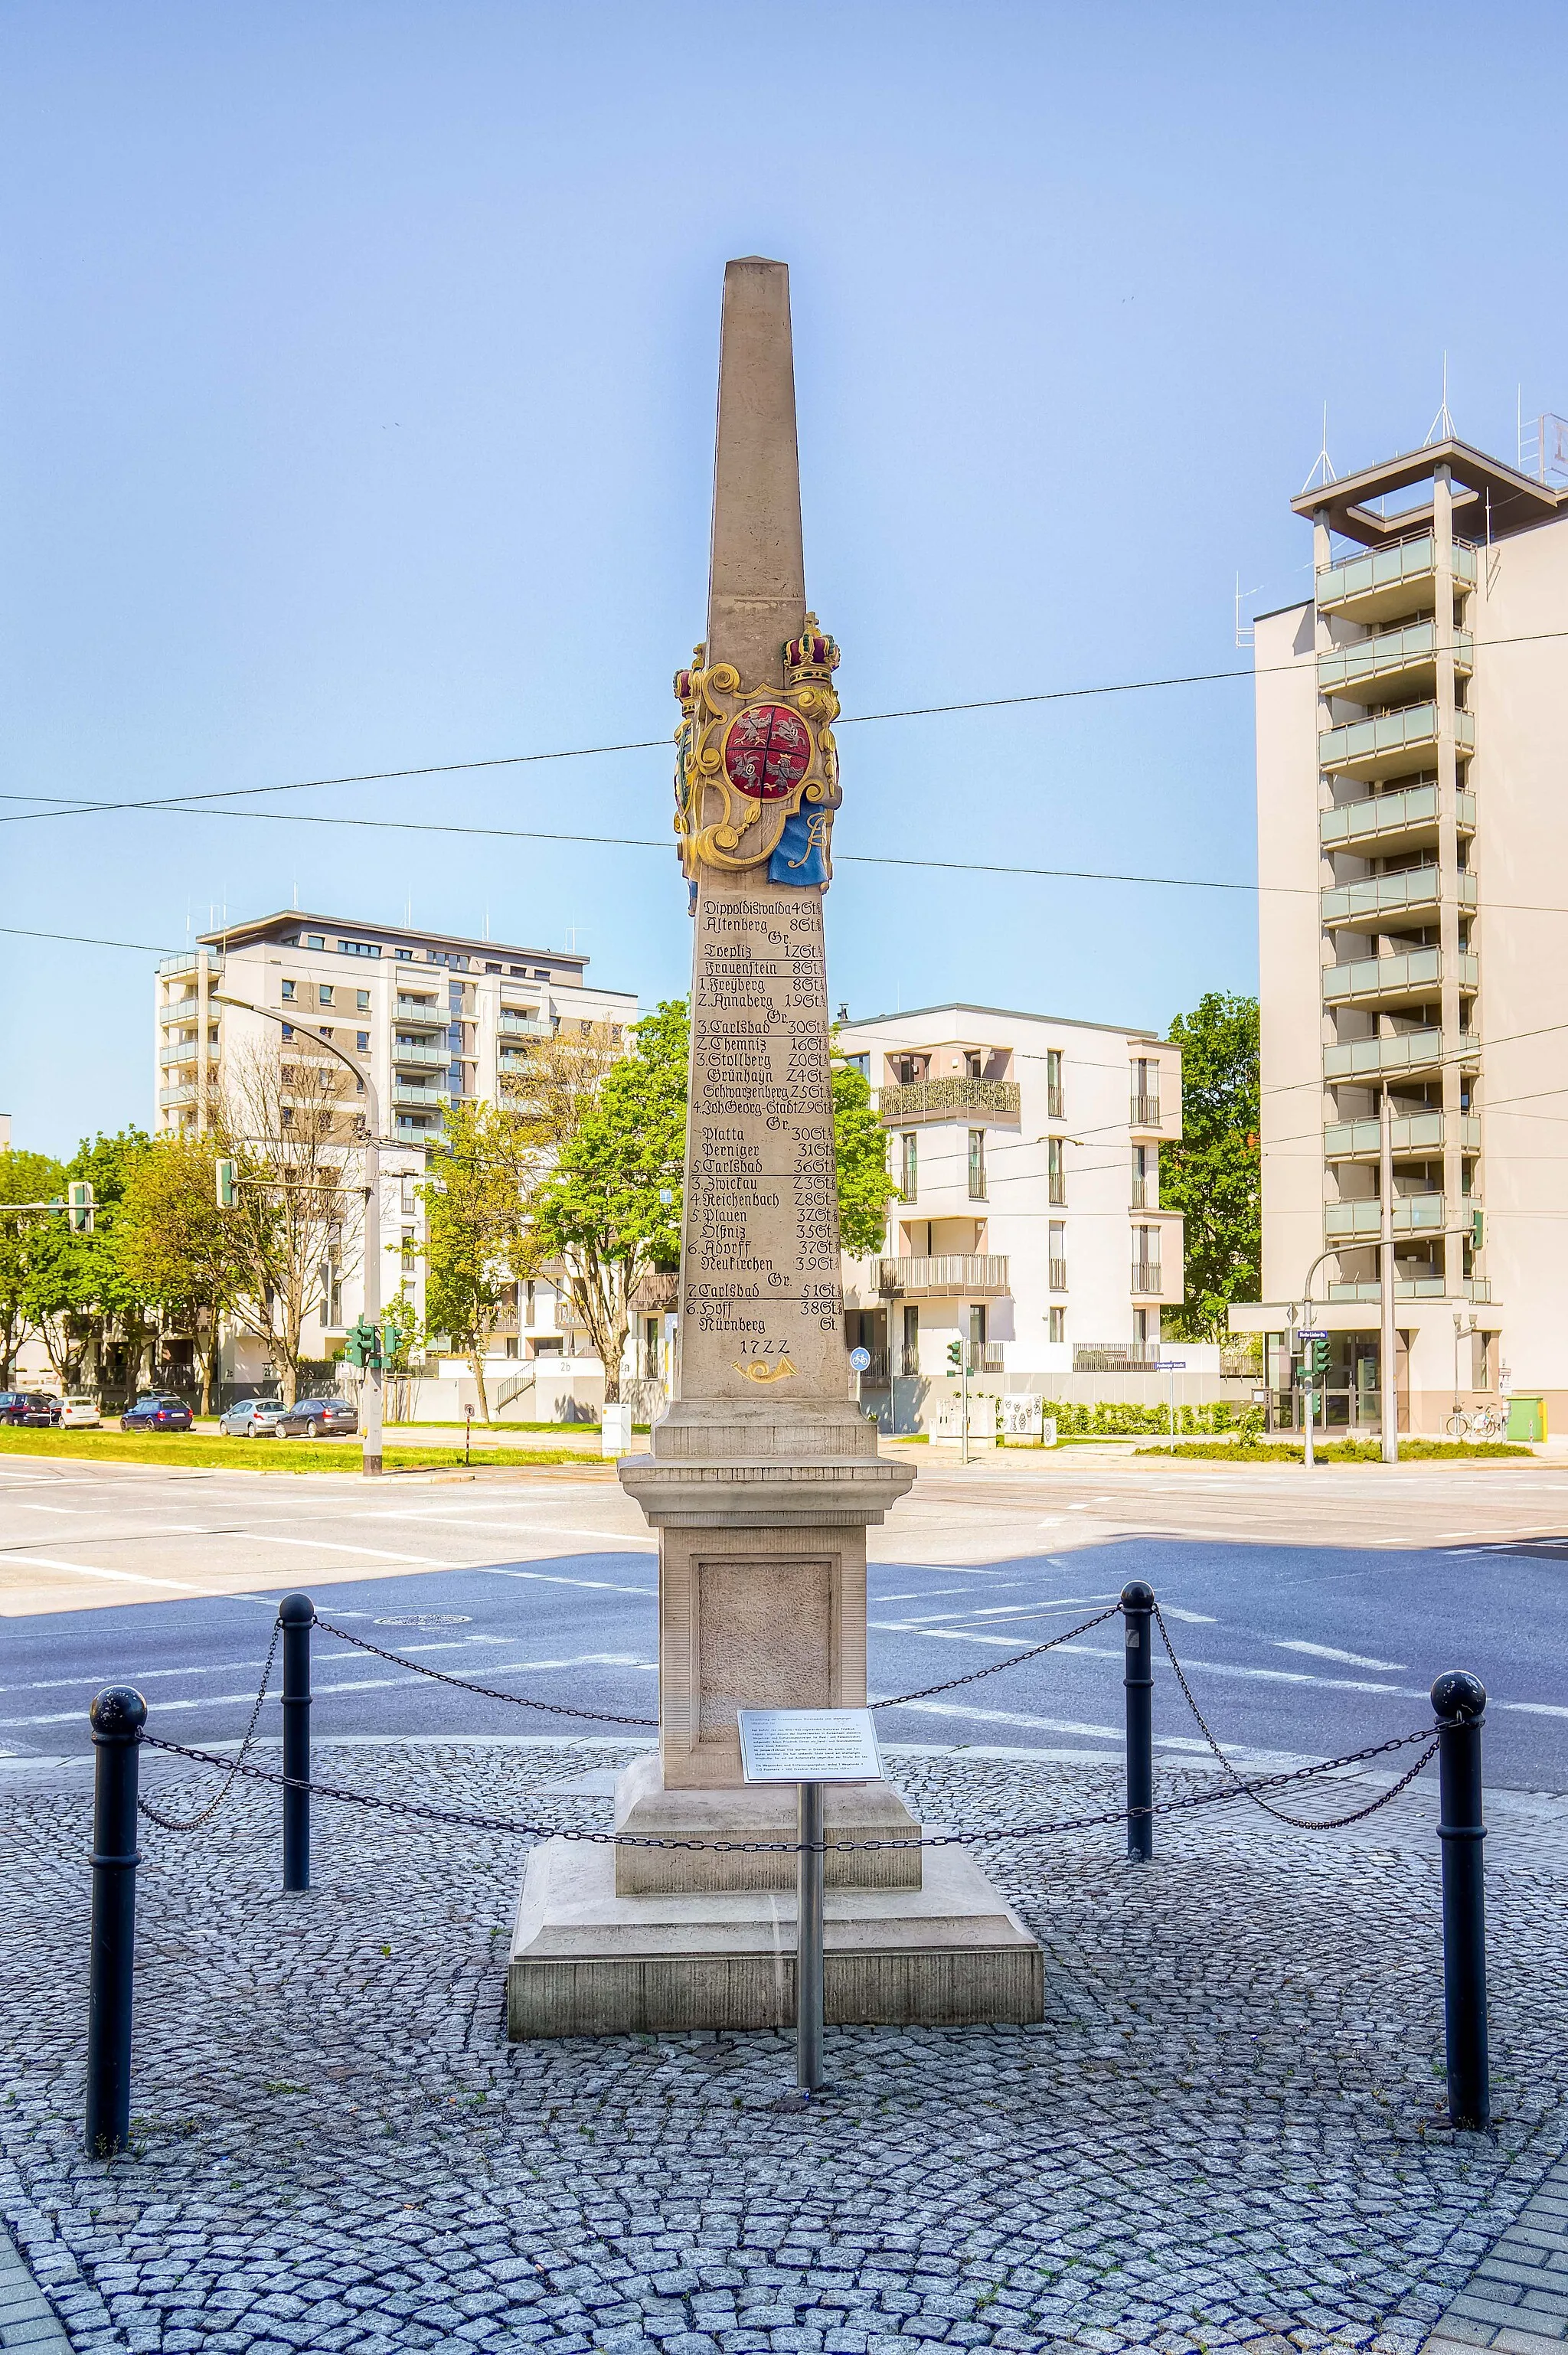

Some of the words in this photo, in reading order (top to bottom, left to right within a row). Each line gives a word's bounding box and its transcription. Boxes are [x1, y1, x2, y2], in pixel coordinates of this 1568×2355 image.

[703, 900, 791, 916] Dippoldiswalda
[703, 917, 768, 934] Altenberg
[768, 931, 792, 945] Gr.
[704, 943, 752, 960] Toepliz
[710, 993, 773, 1010] Annaberg
[767, 1009, 789, 1024] Gr.
[710, 1019, 770, 1034] Carlsbad
[710, 1037, 766, 1053] Chemniz
[707, 1052, 772, 1069] Stollberg
[703, 1083, 789, 1101] Schwarzenberg
[766, 1116, 790, 1131] Gr.
[702, 1127, 744, 1142] Platta
[701, 1142, 760, 1159] Perniger
[703, 1159, 763, 1173] Carlsbad
[704, 1176, 758, 1193] Zwickau
[703, 1192, 779, 1208] Reichenbach
[703, 1208, 747, 1225] Plauen
[701, 1240, 752, 1259] Adorff
[701, 1256, 773, 1272] Neukirchen
[767, 1272, 792, 1286] Gr.
[698, 1283, 760, 1298] Carlsbad
[700, 1301, 735, 1318] Hoff
[698, 1317, 766, 1334] Nürnberg
[820, 1316, 838, 1331] St.
[740, 1340, 790, 1354] 1722
[560, 1361, 571, 1372] 2b
